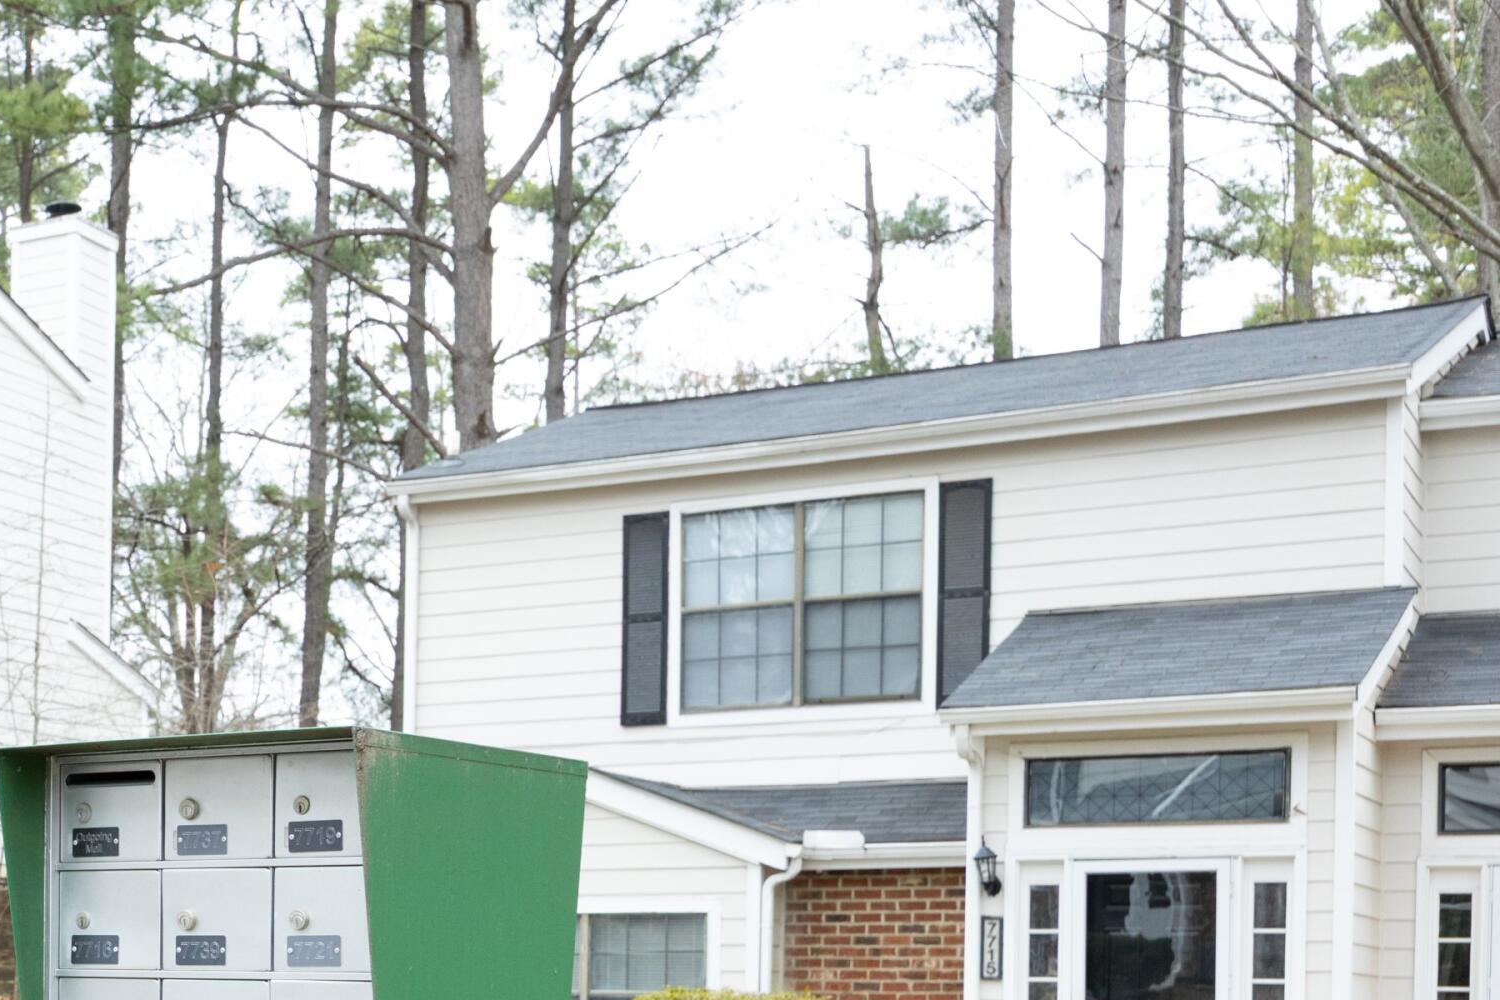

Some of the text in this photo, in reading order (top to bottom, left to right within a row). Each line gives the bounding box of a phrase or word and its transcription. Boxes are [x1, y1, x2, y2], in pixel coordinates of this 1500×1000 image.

[76, 832, 112, 843] Outgoing
[293, 826, 337, 845] 7719
[86, 843, 102, 854] Mail
[180, 940, 221, 960] 7739
[293, 940, 334, 960] 7721
[985, 921, 997, 976] 7715
